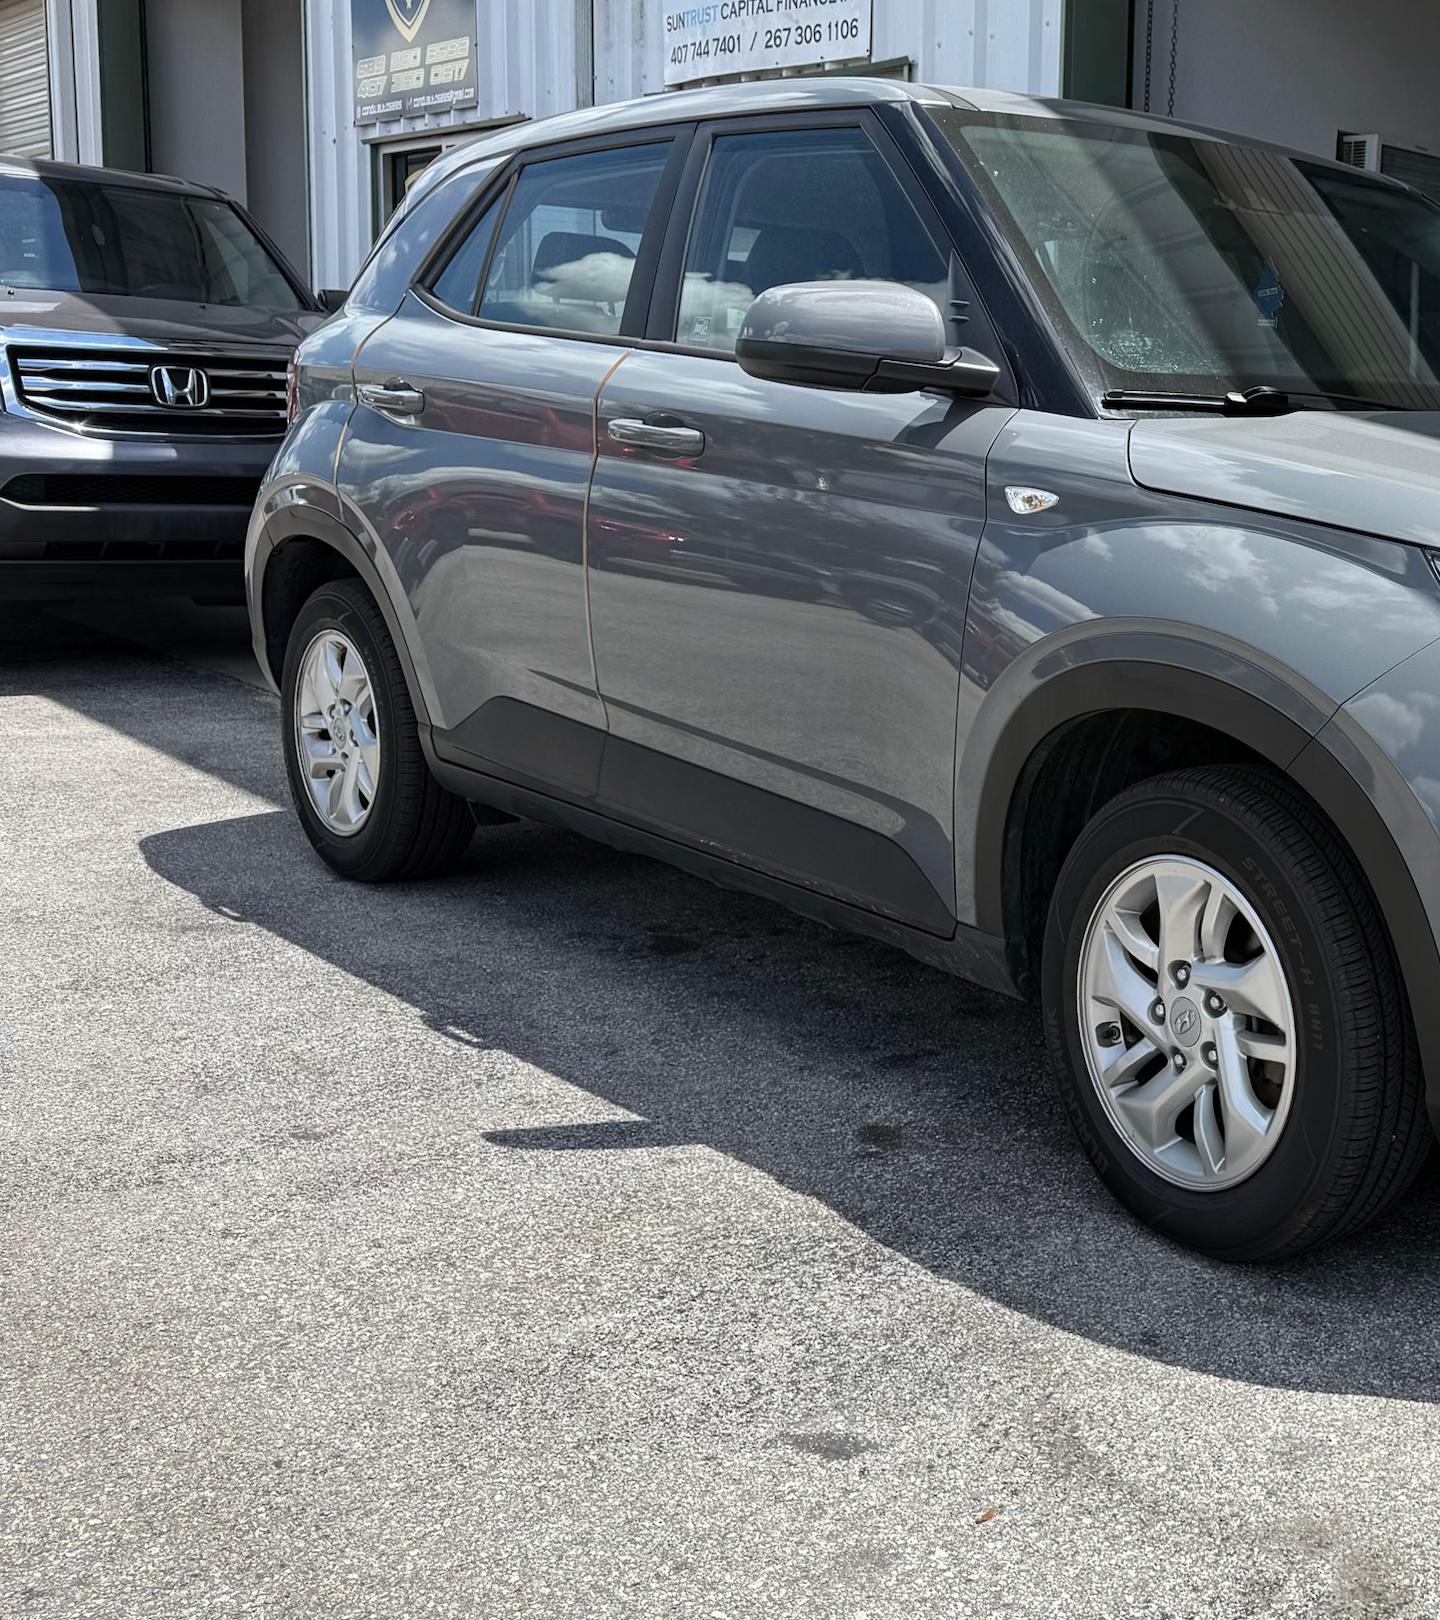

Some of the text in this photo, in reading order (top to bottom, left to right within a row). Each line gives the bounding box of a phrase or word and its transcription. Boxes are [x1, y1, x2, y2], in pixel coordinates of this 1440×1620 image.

[666, 5, 719, 32] SUNTRUST
[720, 0, 773, 20] CAPITAL
[671, 44, 688, 65] 407
[690, 39, 710, 62] 744
[712, 34, 741, 57] 7401
[764, 27, 791, 49] 267
[794, 23, 822, 45] 306
[828, 18, 858, 41] 1106
